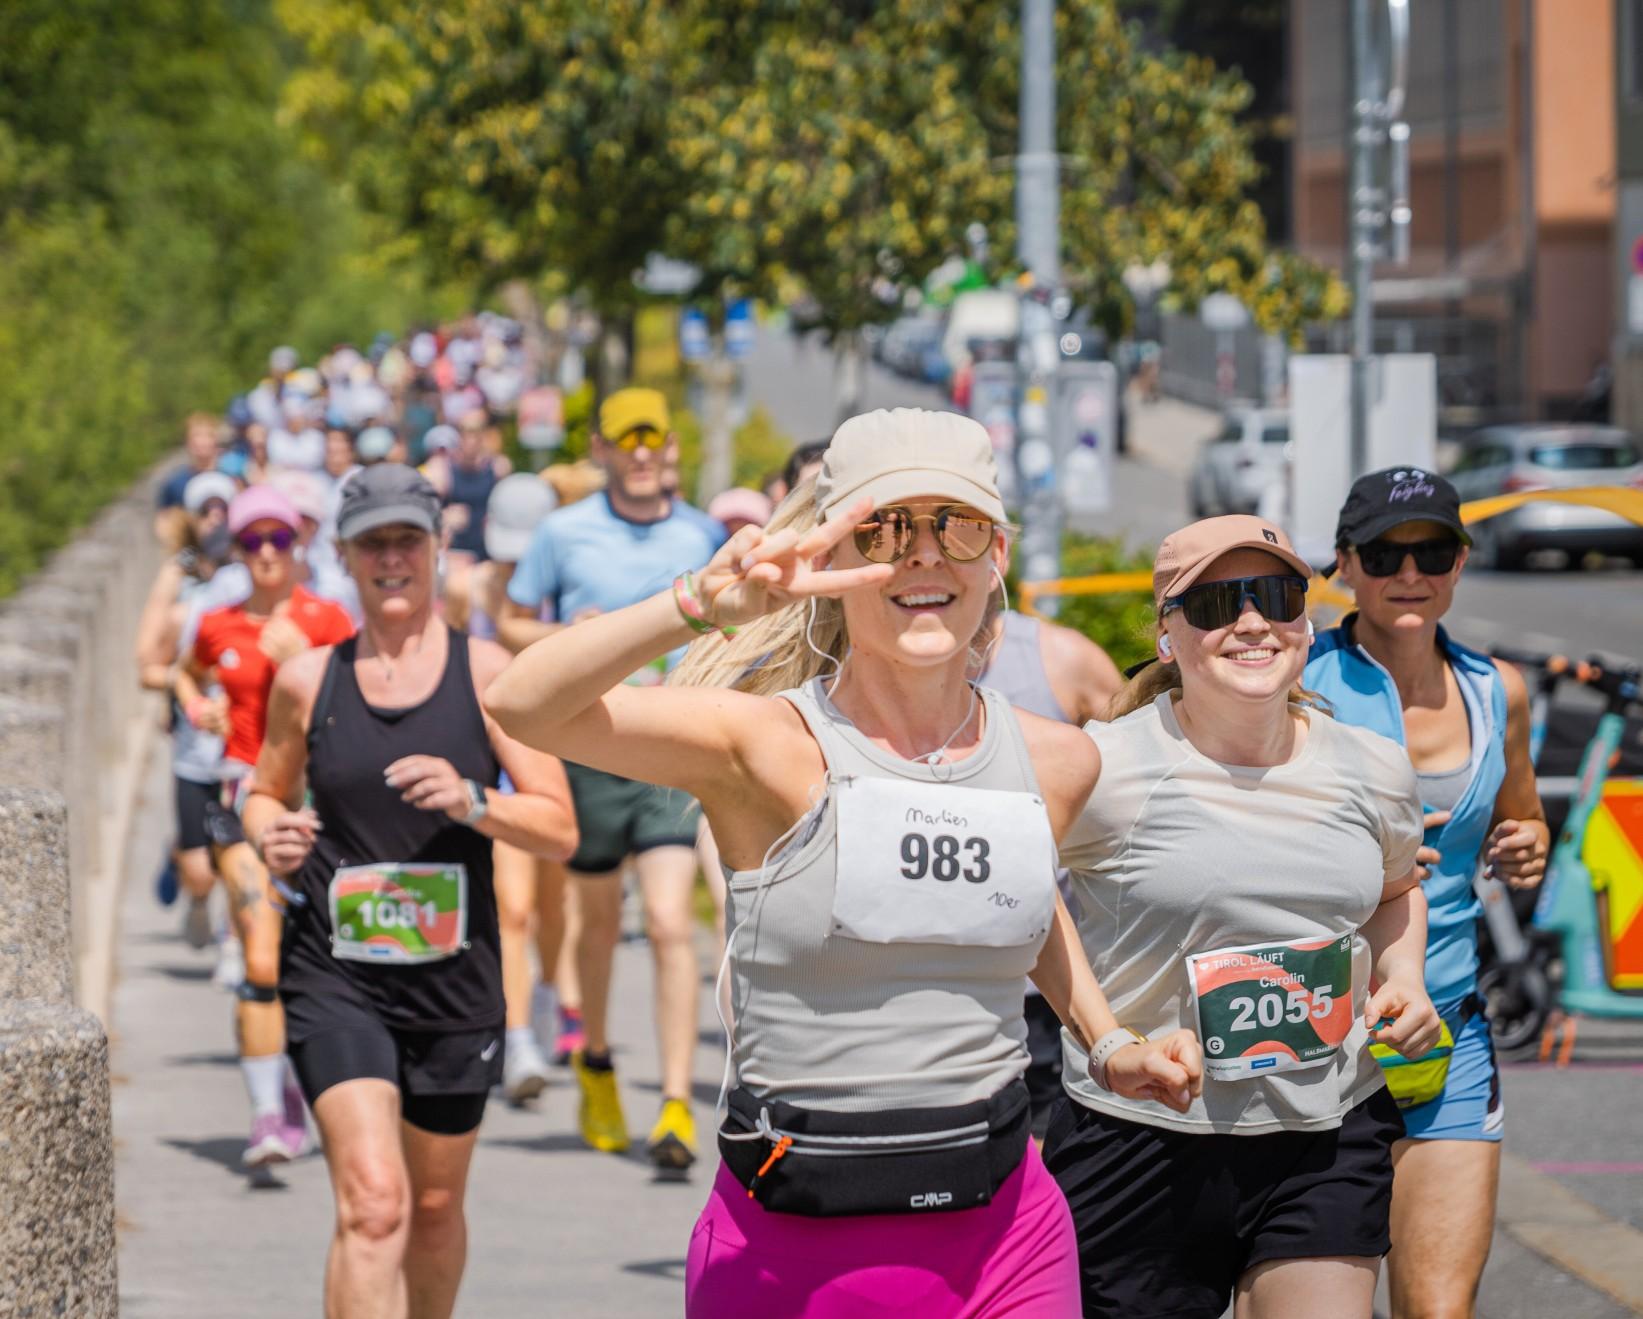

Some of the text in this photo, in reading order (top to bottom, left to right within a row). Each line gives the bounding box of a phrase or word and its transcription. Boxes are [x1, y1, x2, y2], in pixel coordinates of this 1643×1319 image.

[900, 833, 990, 883] 983
[357, 900, 436, 929] 1081
[1213, 957, 1247, 969] TIROL
[1250, 952, 1285, 965] LÄUFT
[1259, 973, 1305, 988] Carolin
[1228, 984, 1333, 1032] 2055
[1209, 1040, 1221, 1050] G
[910, 1191, 953, 1208] CMP
